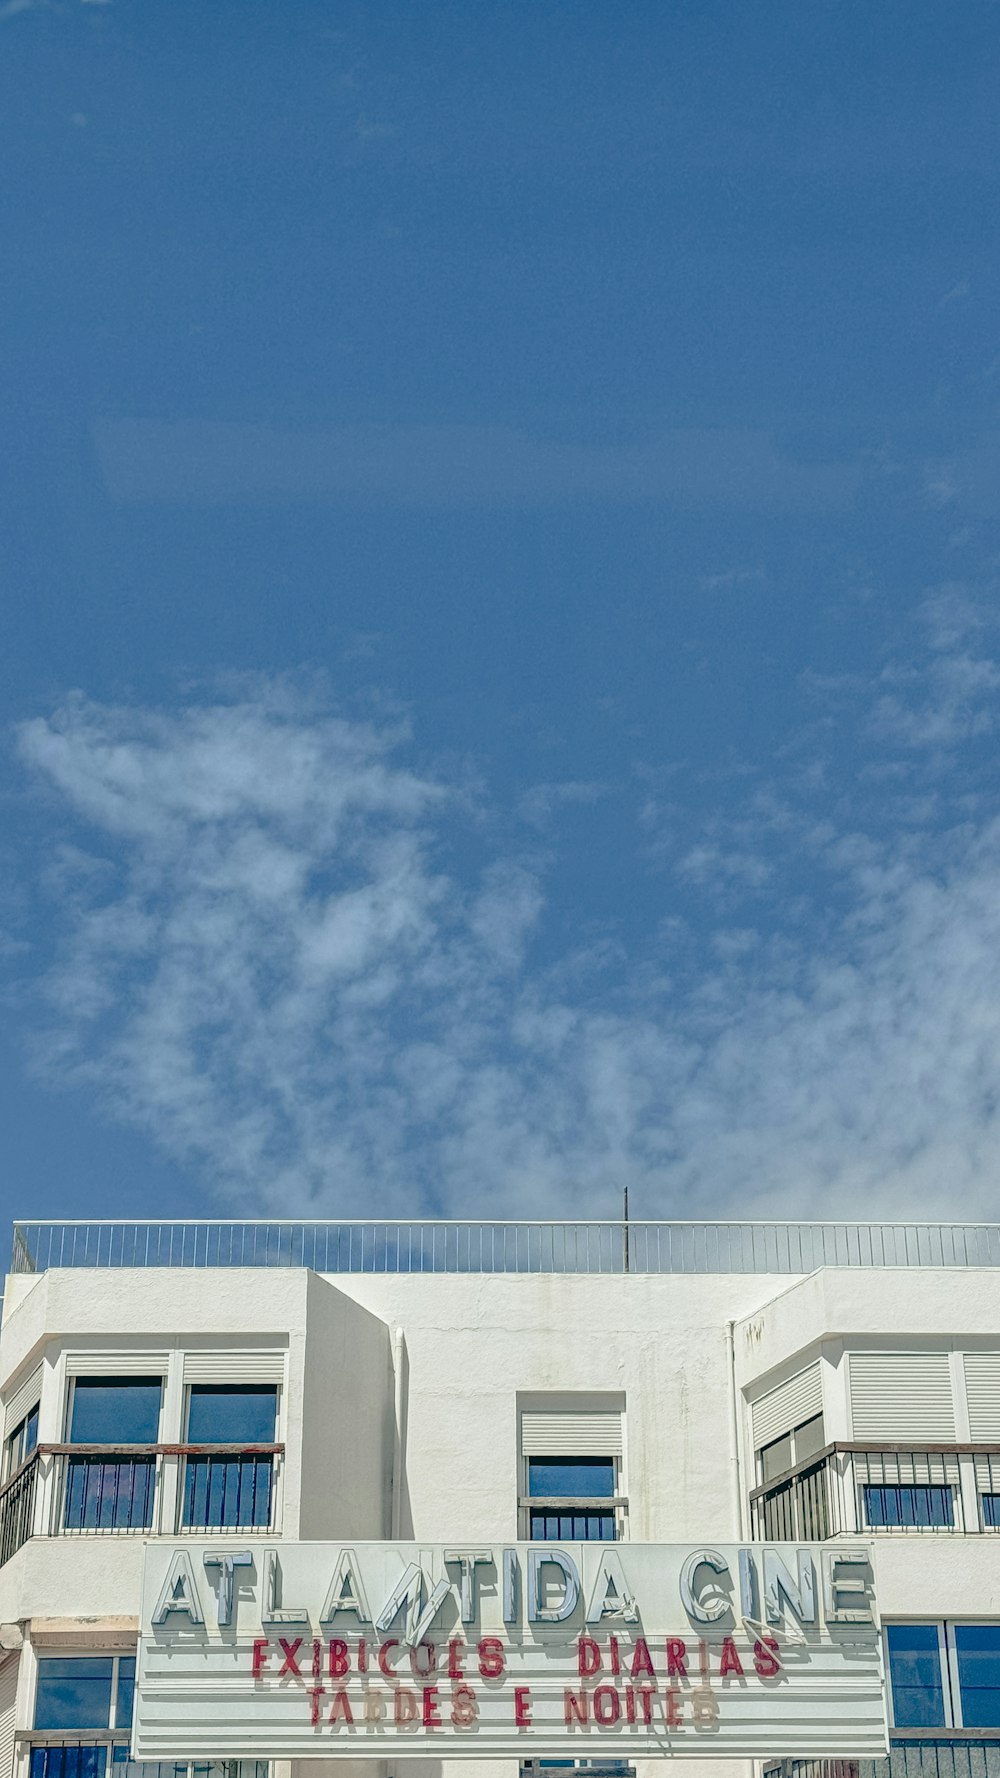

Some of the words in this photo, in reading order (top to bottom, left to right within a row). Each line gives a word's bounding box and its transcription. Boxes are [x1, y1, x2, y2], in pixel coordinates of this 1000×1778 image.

[151, 1549, 639, 1647] ATLANTIDA
[679, 1549, 872, 1623] CINE
[252, 1637, 504, 1679] EXIBICOES
[578, 1636, 780, 1677] DIARIAS
[307, 1686, 476, 1726] TARDES
[514, 1687, 532, 1727] E
[564, 1685, 717, 1726] NOITES
